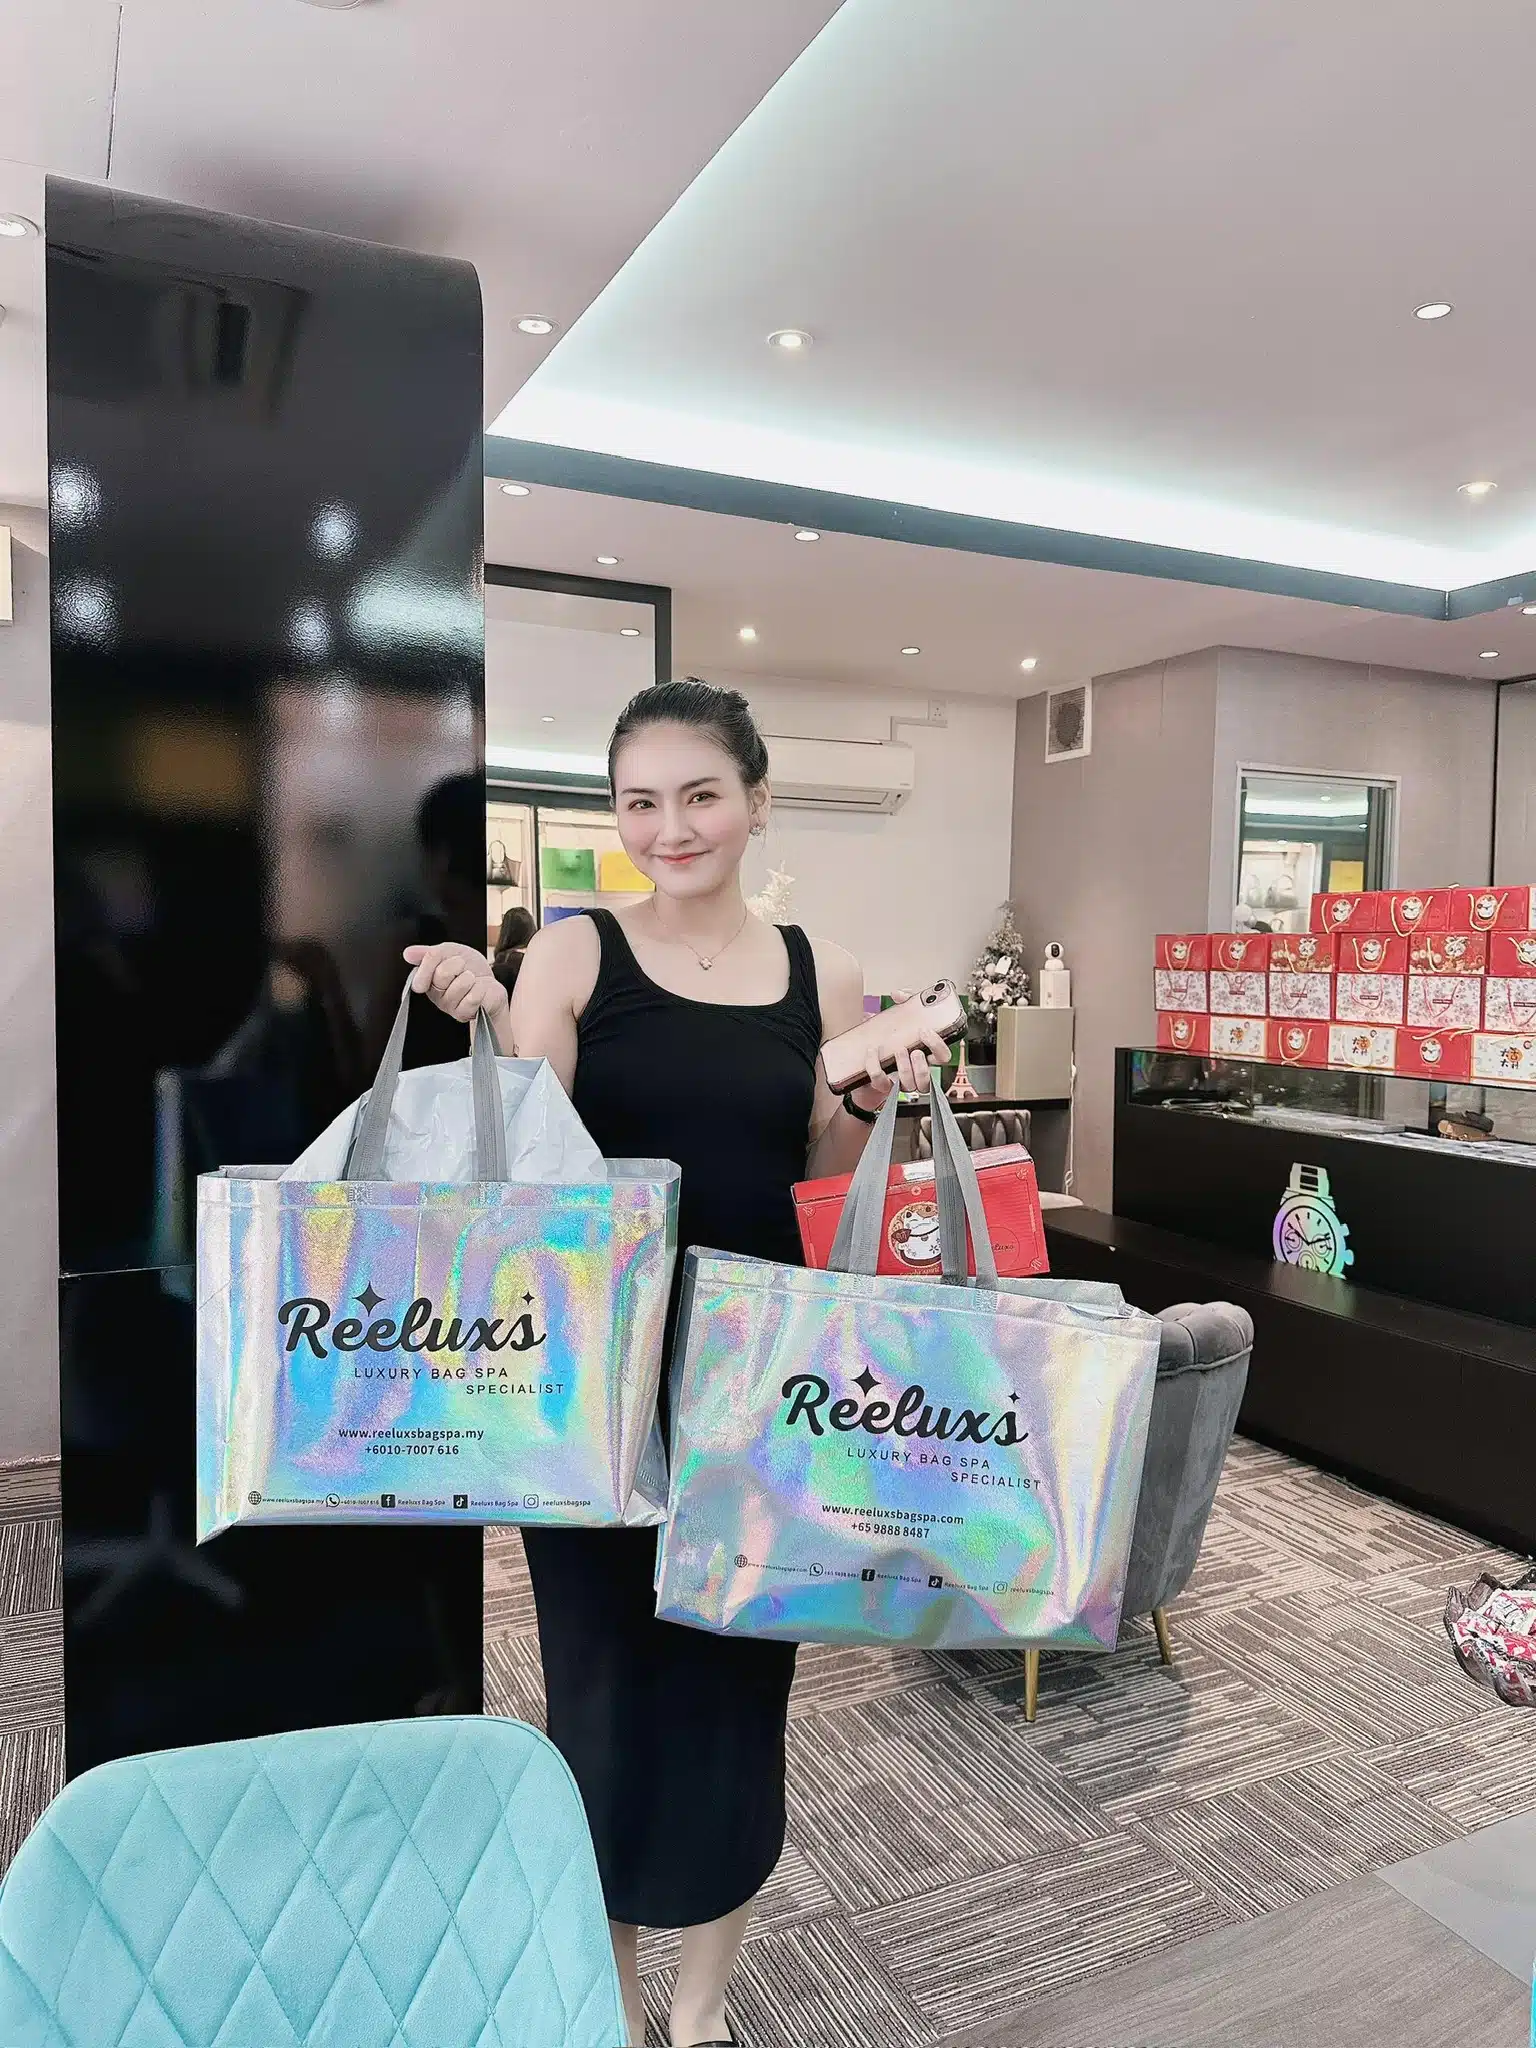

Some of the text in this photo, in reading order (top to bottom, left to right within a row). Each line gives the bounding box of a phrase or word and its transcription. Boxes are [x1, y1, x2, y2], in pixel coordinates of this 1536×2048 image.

[277, 1296, 547, 1359] Reeluxs
[354, 1367, 508, 1380] LUXURY BAG SPA
[466, 1383, 565, 1395] SPECIALIST
[781, 1373, 1030, 1447] Reeluxs
[338, 1427, 485, 1442] www.reeluxsbagspa.my
[846, 1447, 991, 1470] LUXURY BAG SPA
[950, 1471, 1042, 1491] SPECIALIST
[821, 1504, 965, 1526] www.reeluxsbagspa.com
[851, 1521, 930, 1539] +65 9888 8487
